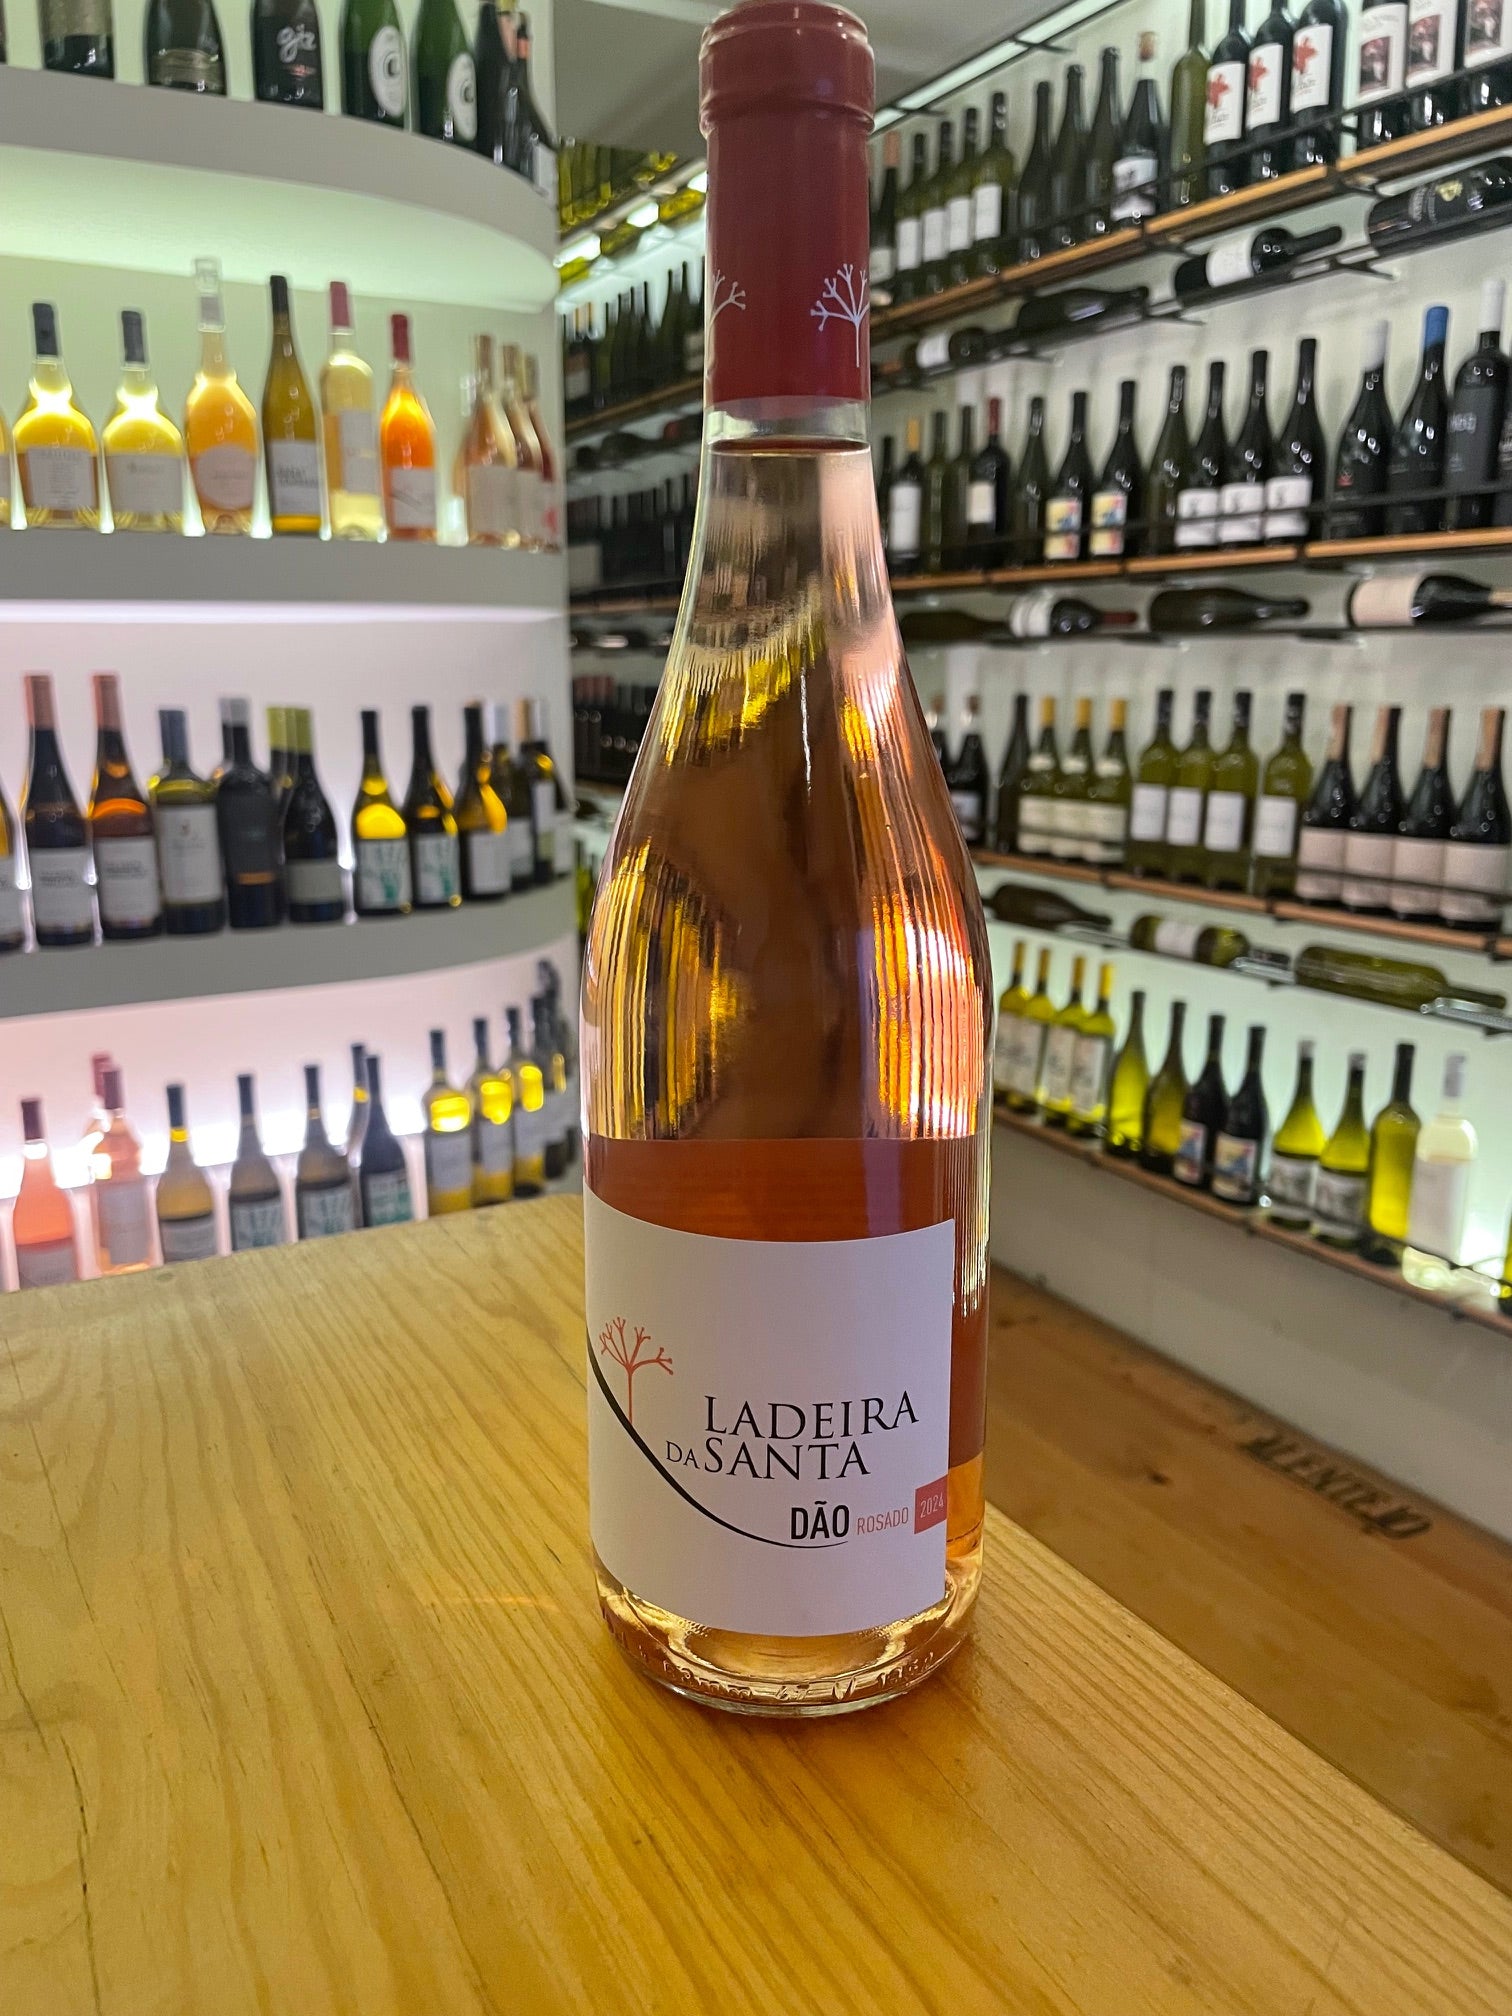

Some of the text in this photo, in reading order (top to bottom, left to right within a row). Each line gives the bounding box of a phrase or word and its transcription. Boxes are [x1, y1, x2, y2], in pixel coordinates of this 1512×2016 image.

[704, 1390, 919, 1440] LADEIRA
[666, 1437, 871, 1480] DA SANTA
[790, 1492, 945, 1539] DÃO ROSADO 2024
